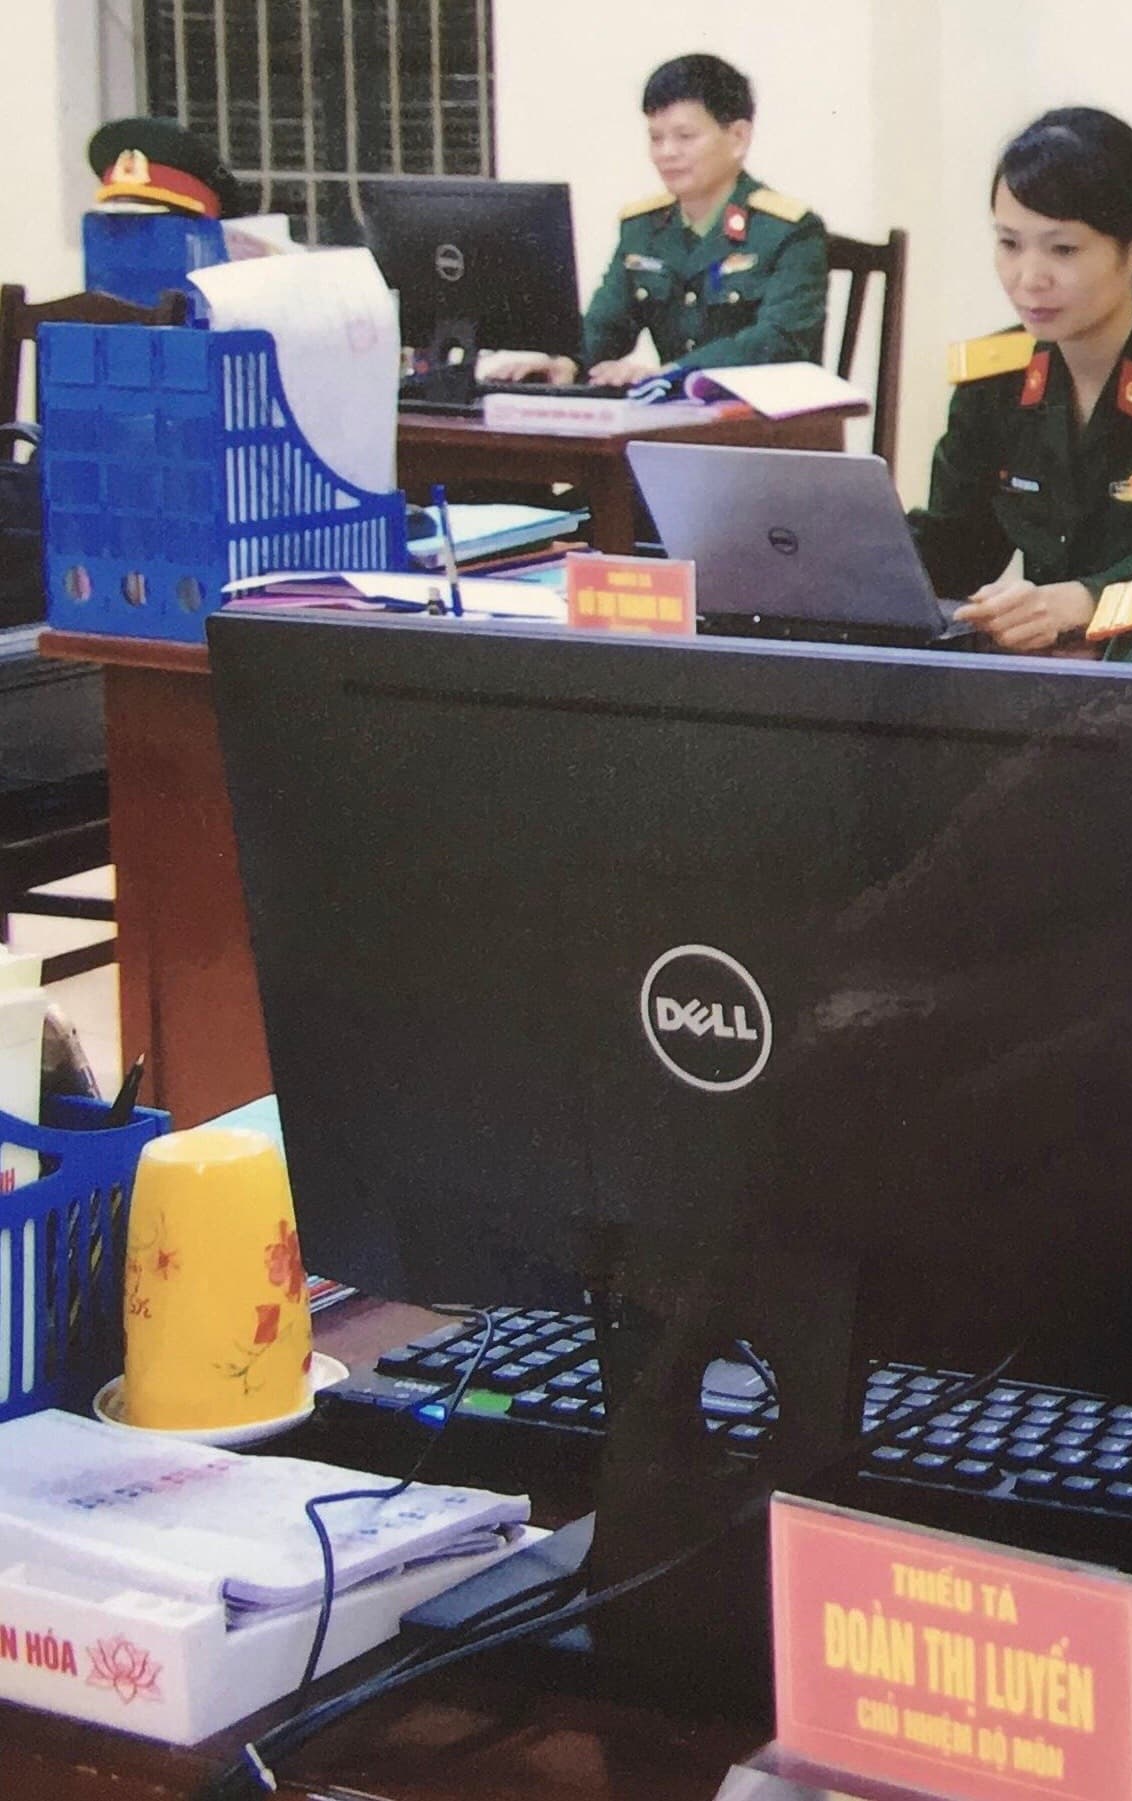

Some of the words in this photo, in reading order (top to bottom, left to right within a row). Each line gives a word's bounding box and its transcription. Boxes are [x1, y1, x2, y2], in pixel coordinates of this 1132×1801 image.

[656, 996, 758, 1041] DELL
[26, 1627, 78, 1677] HÓA
[922, 1626, 977, 1718] THỊ
